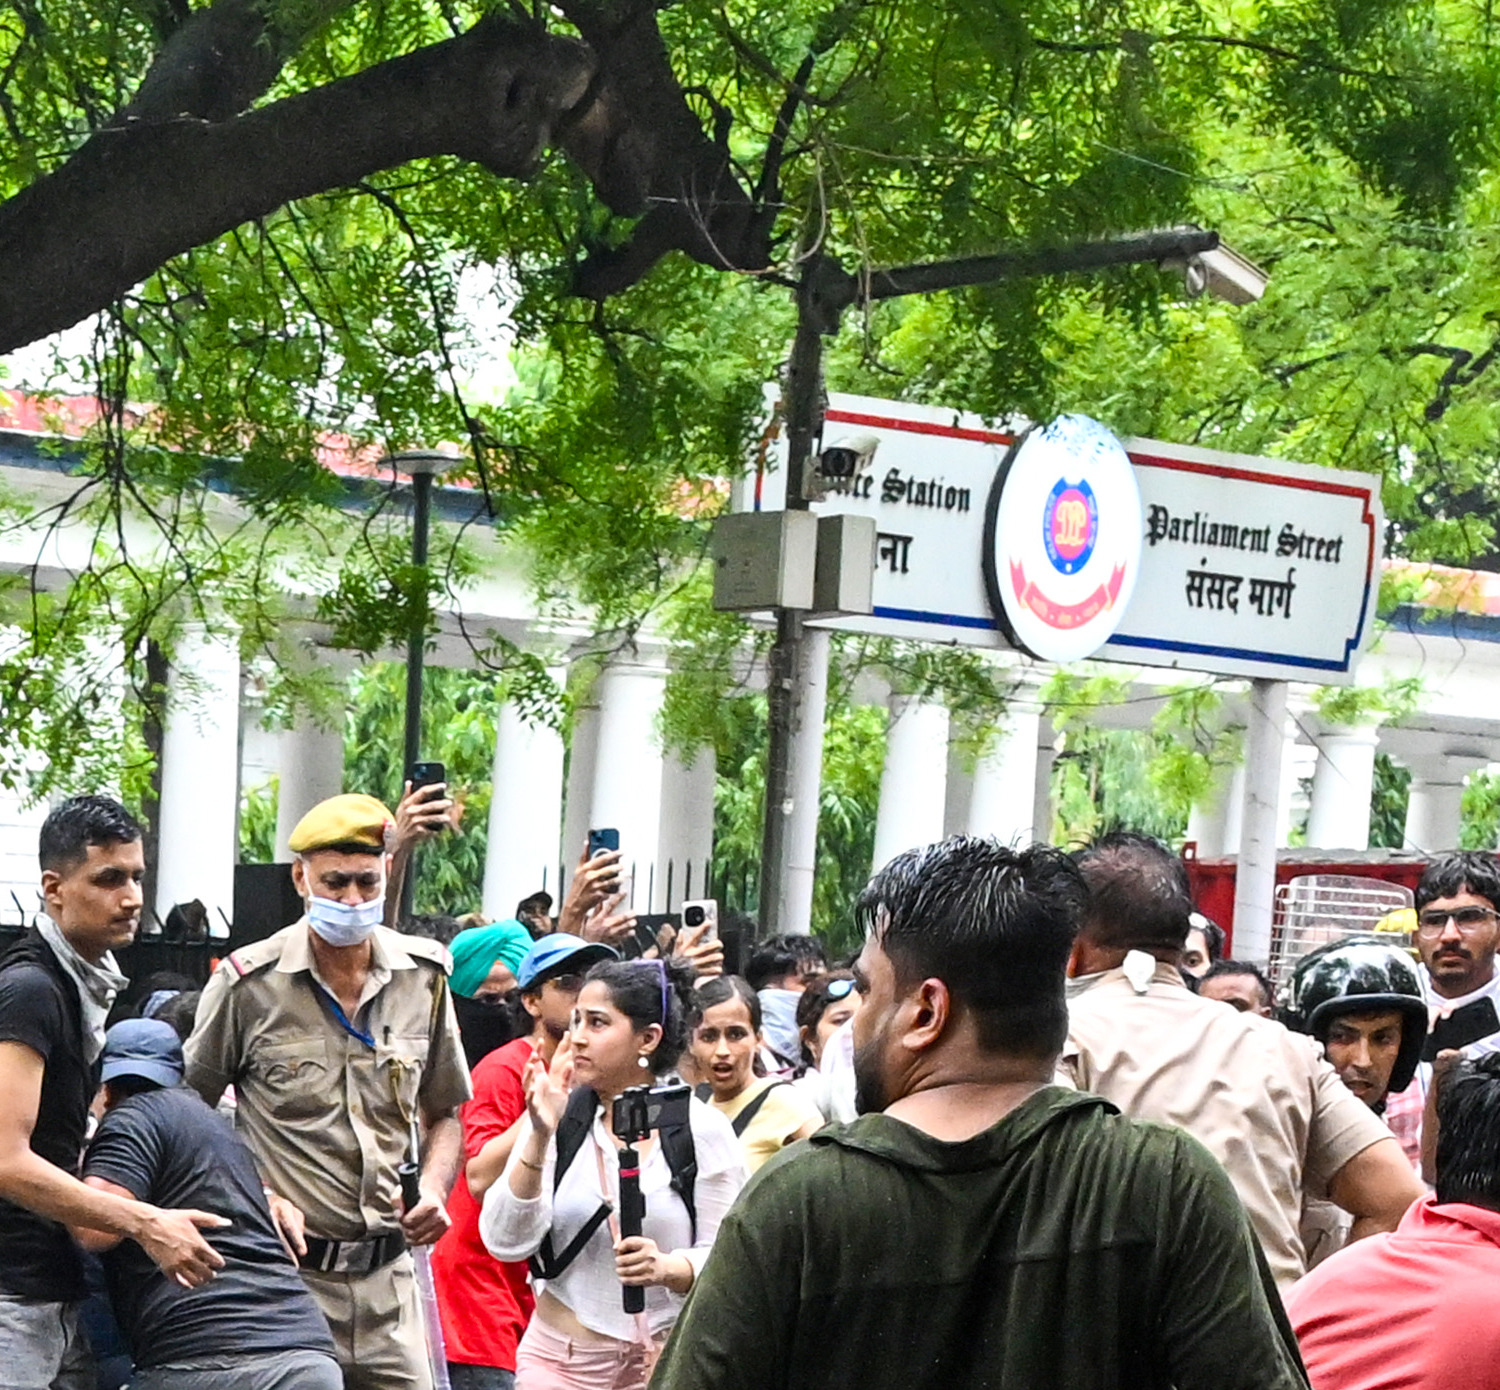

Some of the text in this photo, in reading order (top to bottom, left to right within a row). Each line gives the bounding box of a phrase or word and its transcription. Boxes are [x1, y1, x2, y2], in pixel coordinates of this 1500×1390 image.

[881, 467, 972, 513] Station
[1145, 503, 1271, 553] Parliament
[1275, 522, 1344, 564] Street
[1185, 557, 1297, 619] संसद मार्ग
